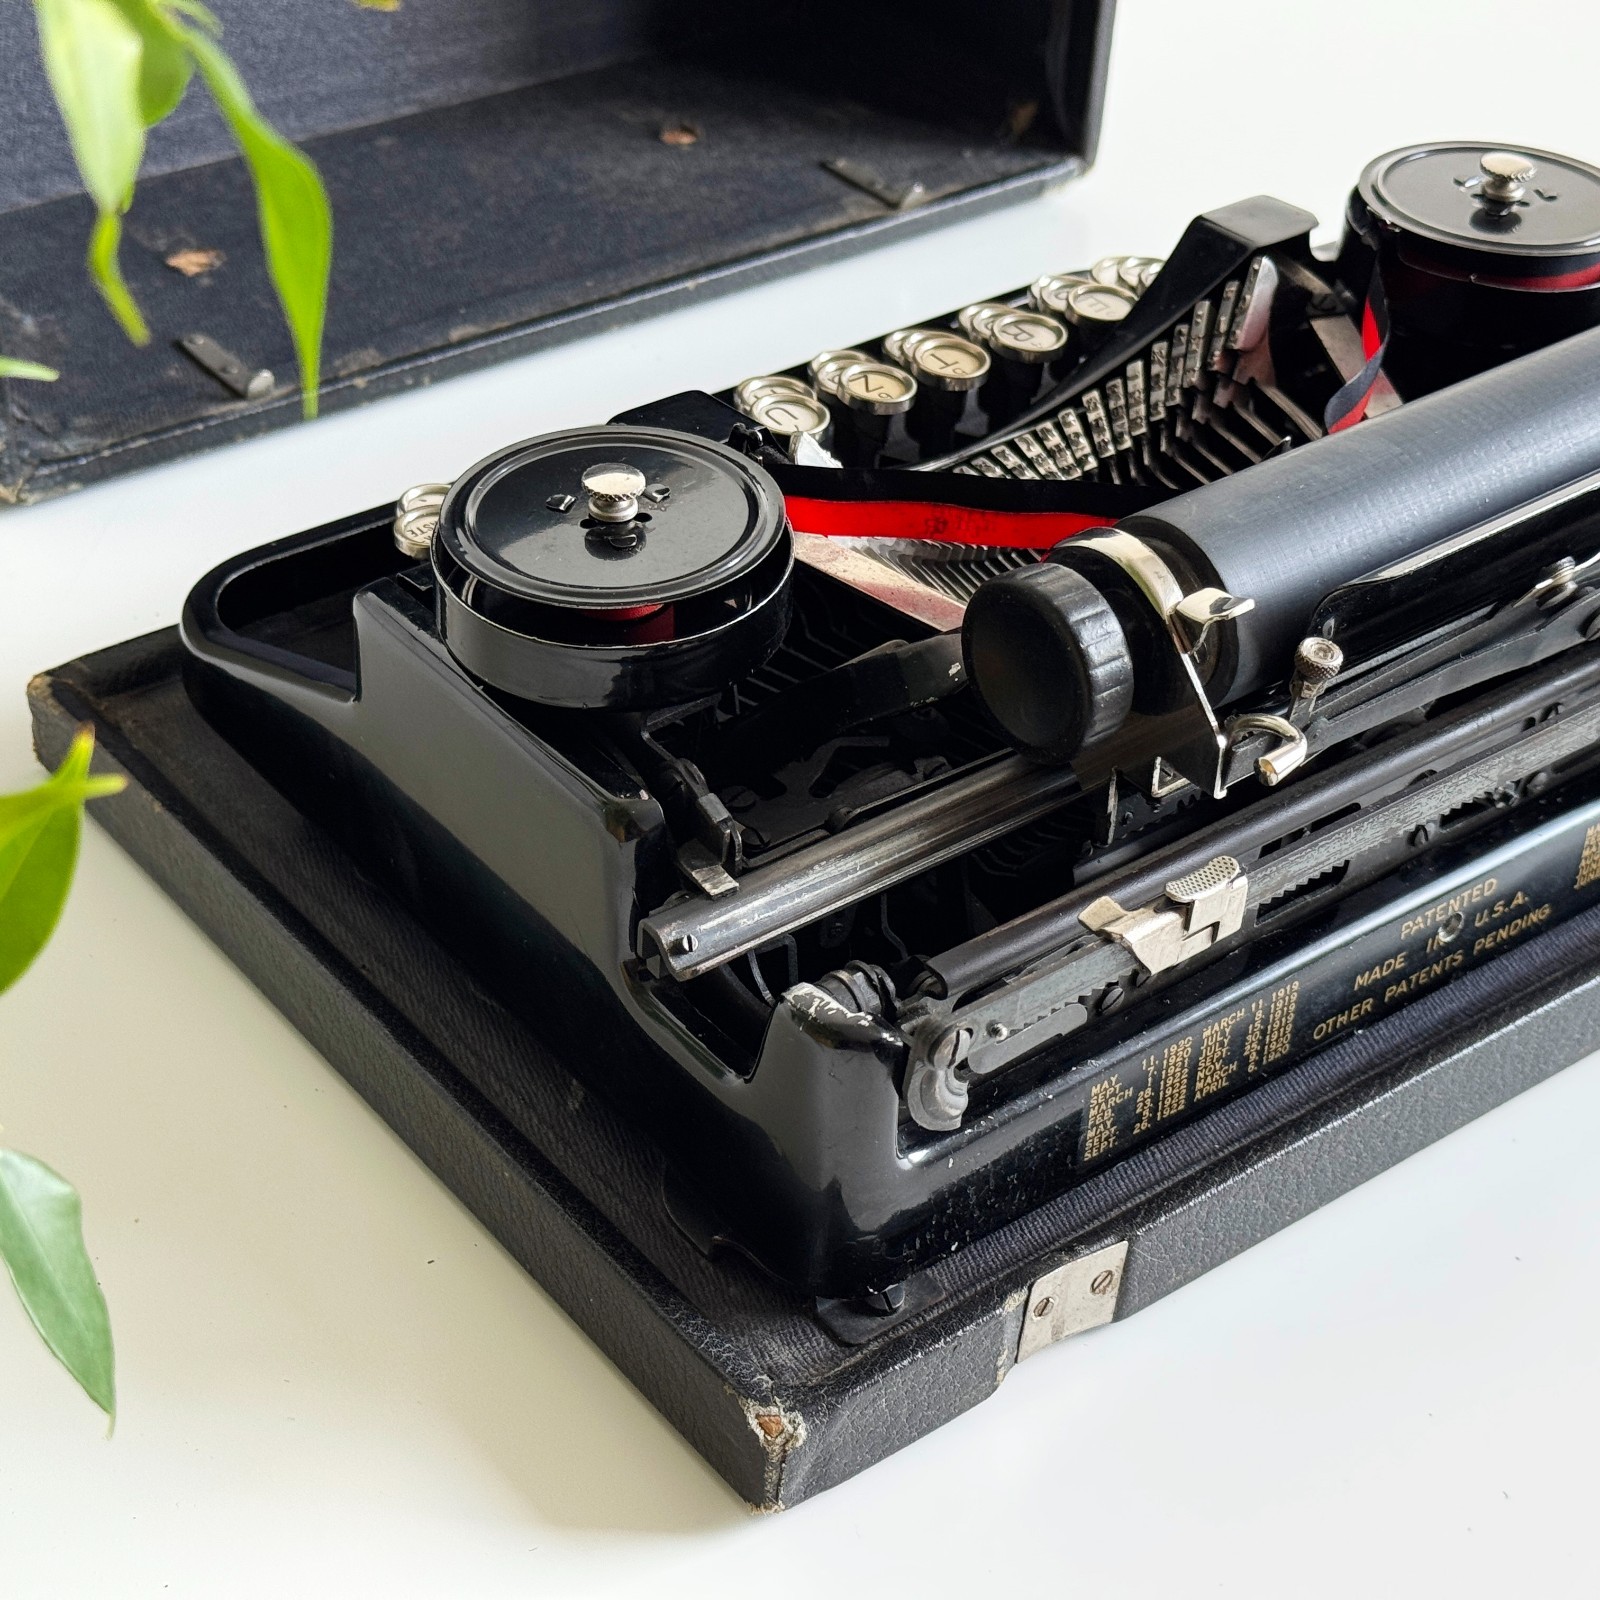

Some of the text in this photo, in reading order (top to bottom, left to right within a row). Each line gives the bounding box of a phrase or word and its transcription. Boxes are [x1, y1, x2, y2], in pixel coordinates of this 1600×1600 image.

[930, 353, 959, 370] T
[1000, 324, 1034, 342] R
[765, 408, 799, 426] U
[1401, 878, 1498, 940] PATENTED
[1354, 951, 1409, 991] MADE
[1474, 890, 1530, 928] U.S.A.
[1313, 903, 1552, 1041] OTHER PATENTS PENDING
[1199, 1035, 1231, 1061] JULY
[1269, 1003, 1296, 1024] 1919
[1200, 1024, 1232, 1050] JULY
[1271, 992, 1298, 1014] 1919
[1203, 1008, 1245, 1040] MARCH
[1272, 980, 1299, 1002] 1919
[1266, 1023, 1292, 1044] 1919
[1267, 1013, 1295, 1035] 1919
[1091, 1074, 1118, 1097] MAY
[1163, 1036, 1193, 1058] 1920
[1160, 1068, 1189, 1090] 1922
[1162, 1047, 1192, 1069] 1920
[1193, 1077, 1230, 1103] APRIL
[1262, 1044, 1289, 1065] 1920
[1195, 1061, 1238, 1091] MARCH
[1264, 1033, 1291, 1055] 1920
[1086, 1118, 1114, 1140] MAY
[1159, 1079, 1188, 1101] 1922
[1089, 1086, 1134, 1118] MARCH
[1161, 1058, 1189, 1079] 1921
[1157, 1099, 1185, 1121] 1922
[1158, 1089, 1187, 1111] 1922
